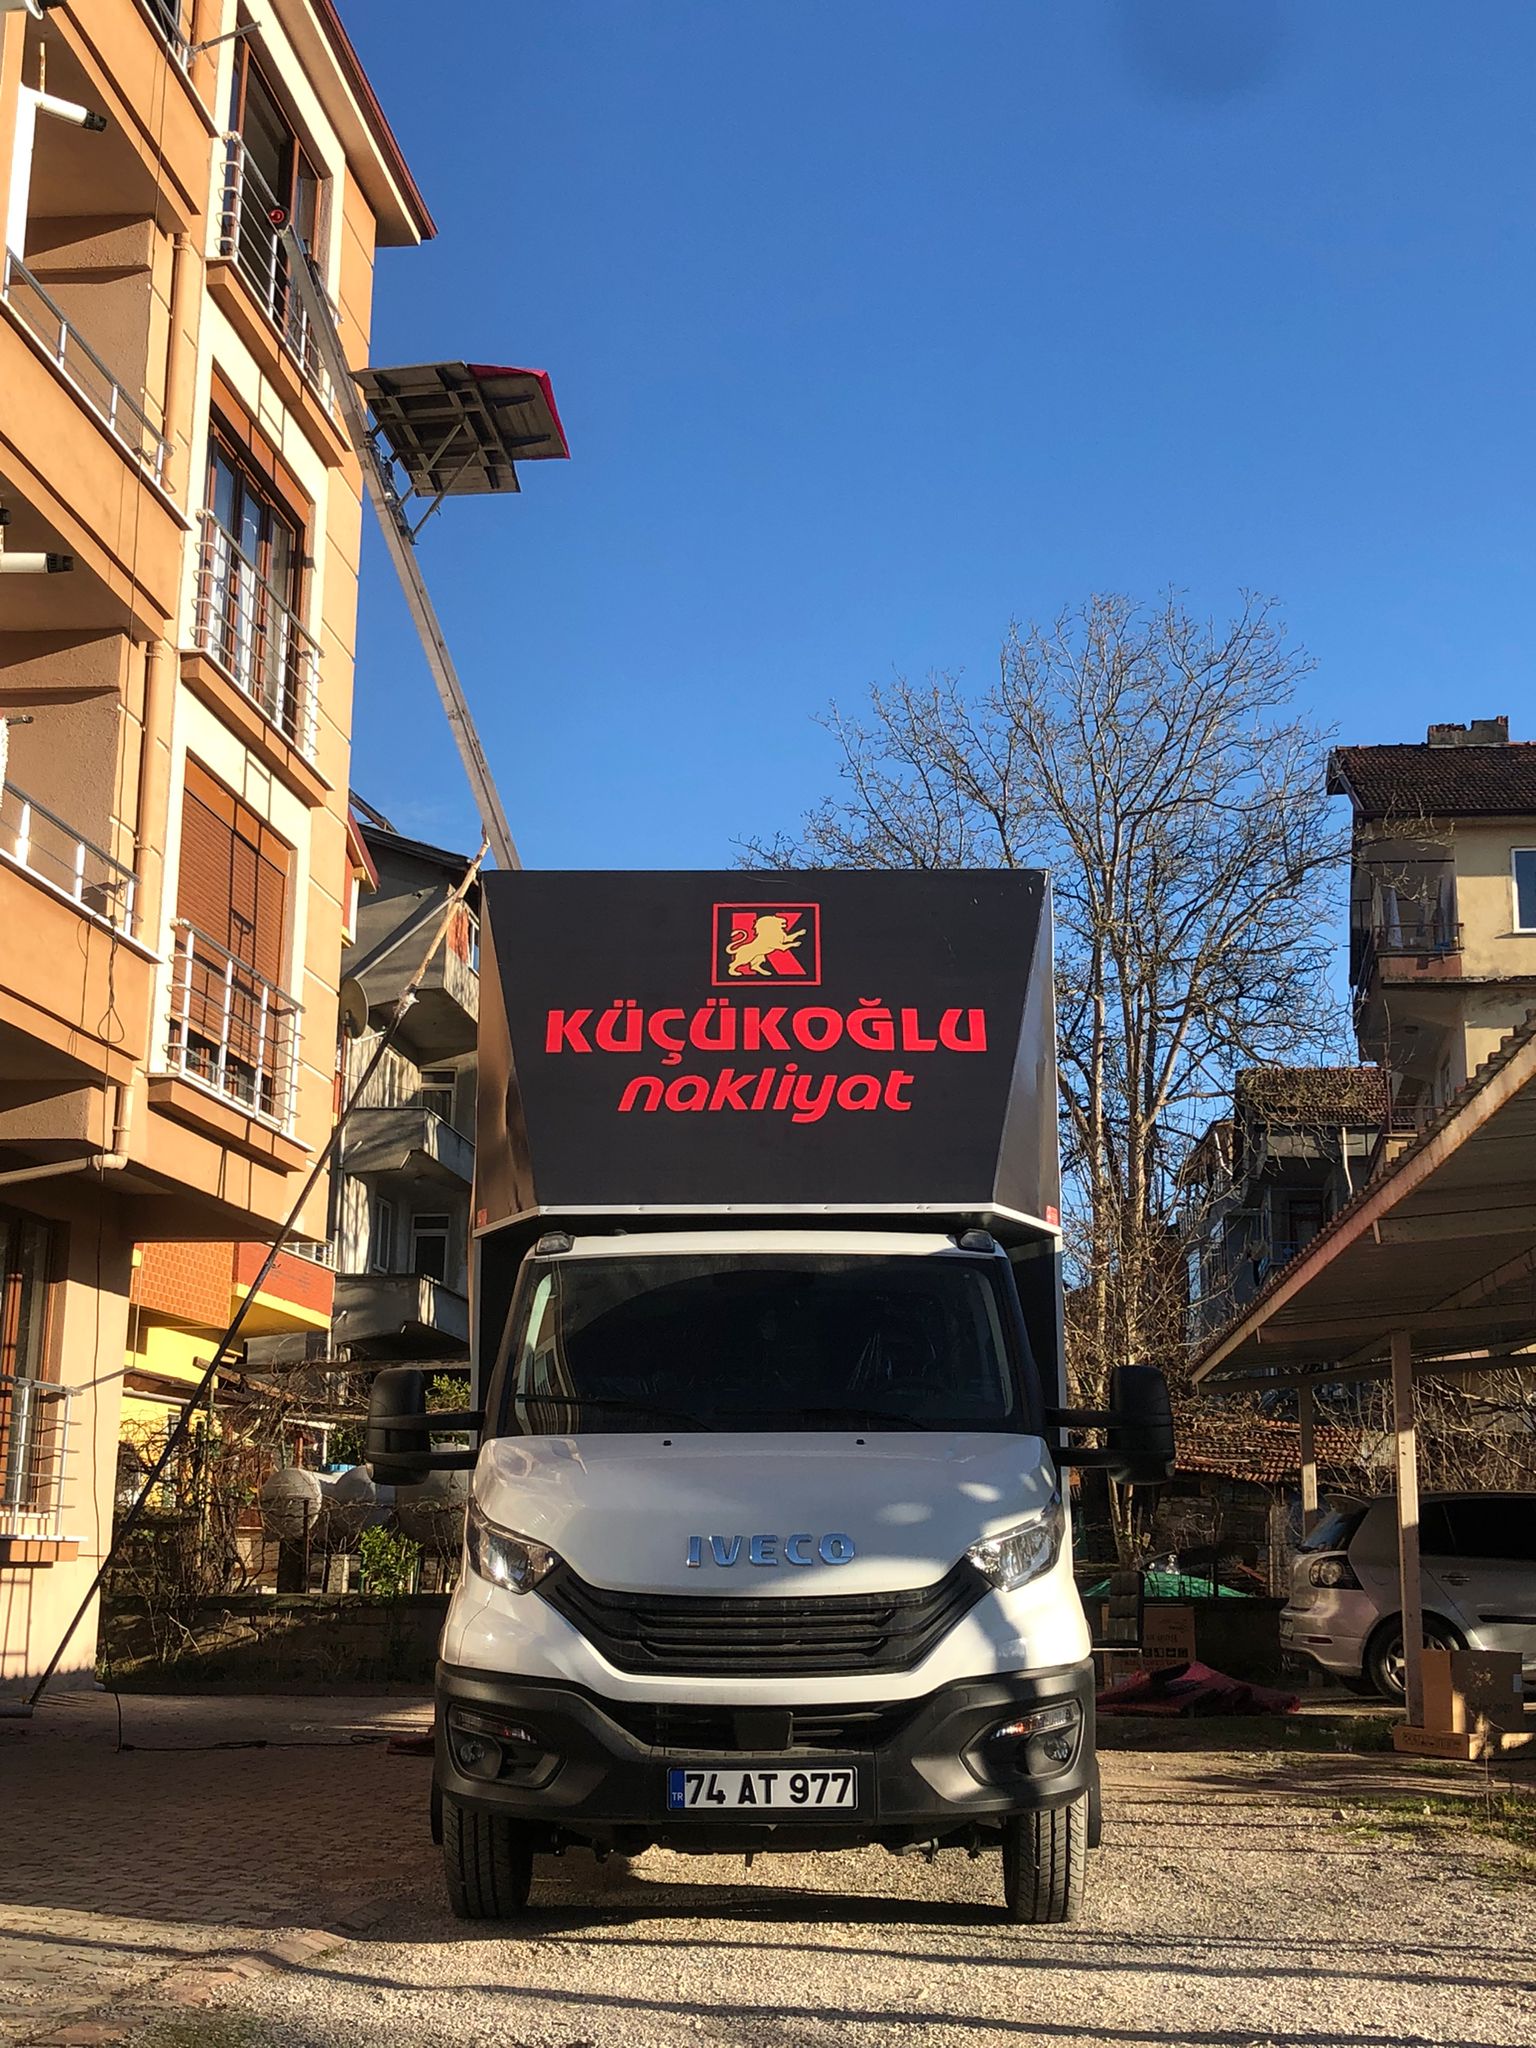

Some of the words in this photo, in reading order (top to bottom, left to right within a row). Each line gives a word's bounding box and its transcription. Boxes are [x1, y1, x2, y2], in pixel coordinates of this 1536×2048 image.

[545, 997, 988, 1065] KÜÇÜKOĞLU
[617, 1063, 914, 1123] nakliyat
[686, 1533, 856, 1567] IVECO
[671, 1791, 684, 1801] TR
[686, 1773, 726, 1805] 74
[738, 1773, 778, 1805] AT
[789, 1772, 851, 1805] 977
